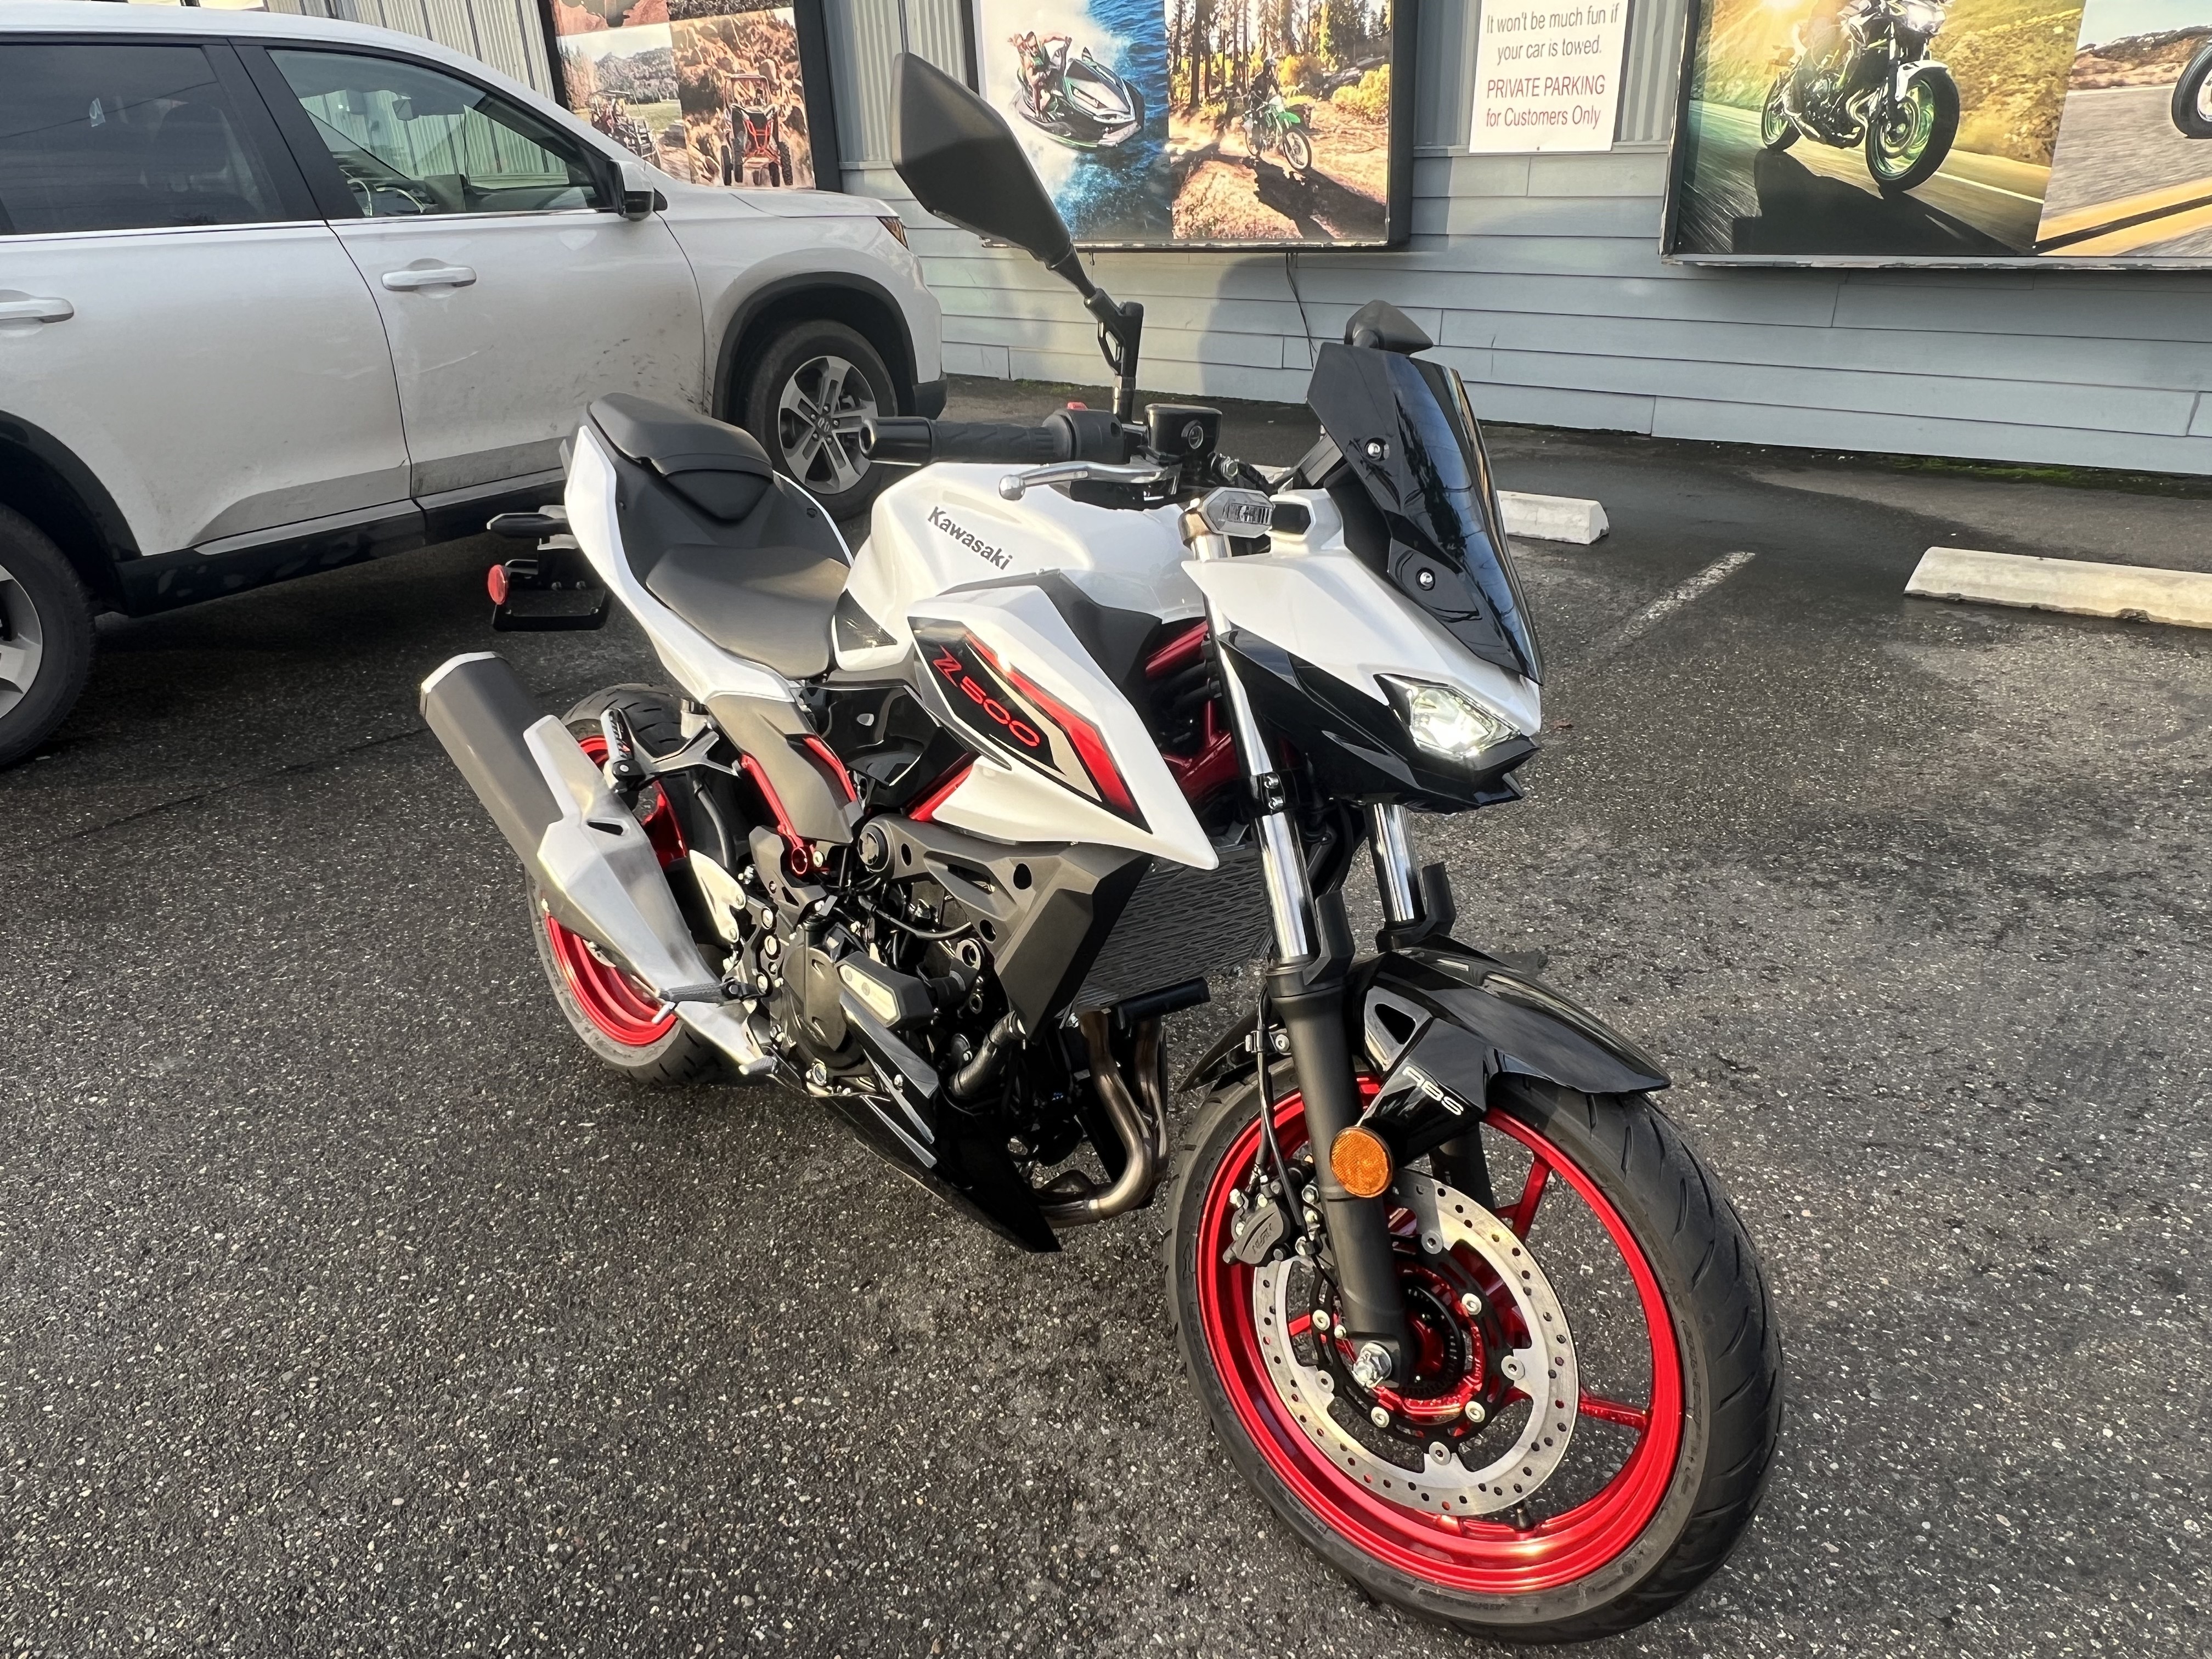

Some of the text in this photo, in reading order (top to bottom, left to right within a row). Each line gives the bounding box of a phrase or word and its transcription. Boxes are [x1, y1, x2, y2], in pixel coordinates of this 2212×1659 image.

[1487, 2, 1621, 34] It won't be much fun if
[1497, 35, 1602, 66] your car is towed.
[1487, 75, 1605, 99] PRIVATE PARKING
[1486, 105, 1601, 129] for Customers Only
[927, 506, 1013, 571] Kawasaki
[1402, 1066, 1464, 1116] ABS
